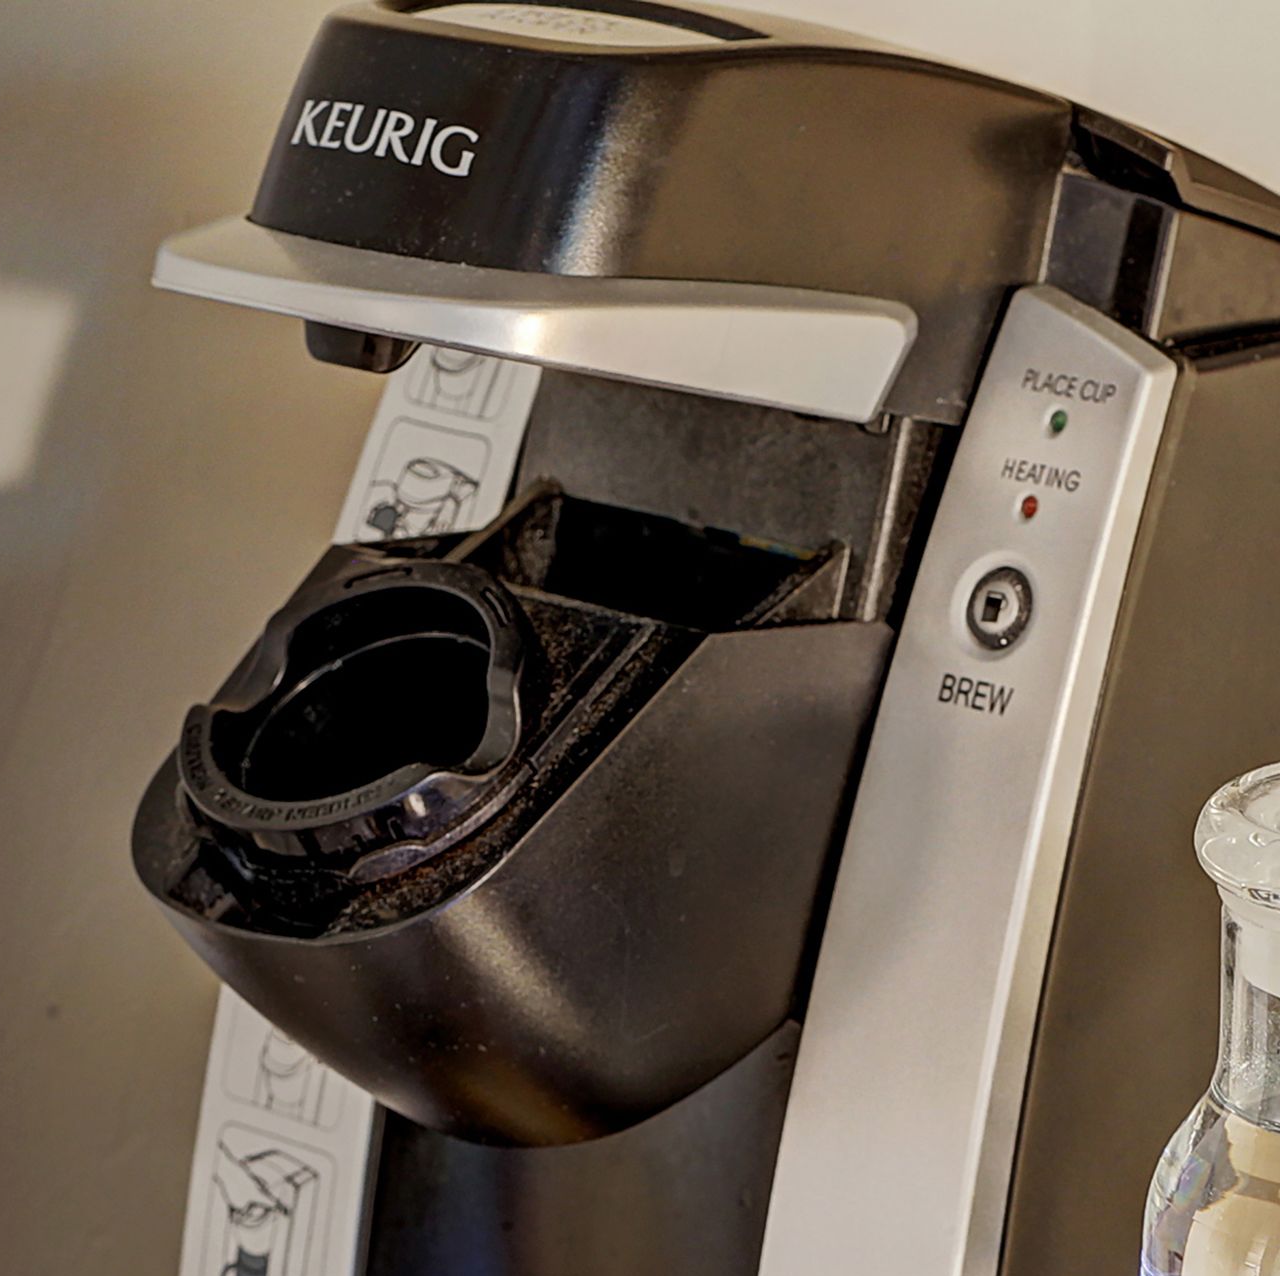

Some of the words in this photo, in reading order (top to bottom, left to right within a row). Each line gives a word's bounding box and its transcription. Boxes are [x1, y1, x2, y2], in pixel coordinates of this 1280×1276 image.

[291, 99, 479, 177] KEURIG
[1022, 369, 1075, 400] PLACE
[1079, 379, 1117, 405] CUP
[1001, 458, 1081, 492] HEATING
[938, 673, 1014, 716] BREW
